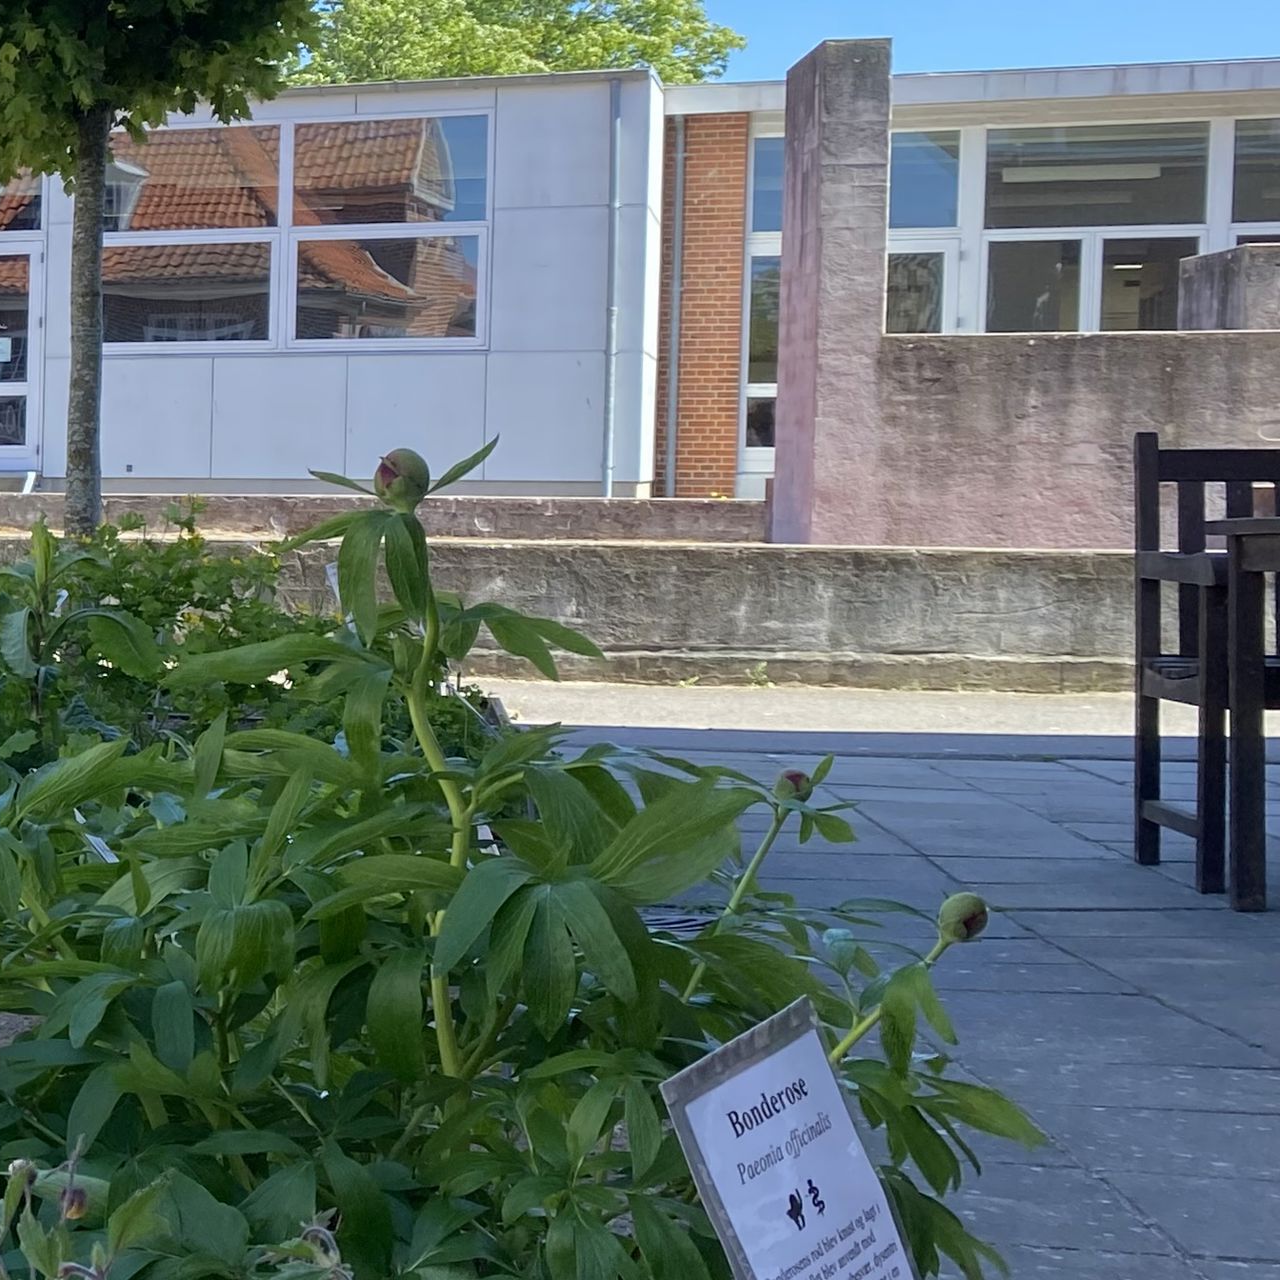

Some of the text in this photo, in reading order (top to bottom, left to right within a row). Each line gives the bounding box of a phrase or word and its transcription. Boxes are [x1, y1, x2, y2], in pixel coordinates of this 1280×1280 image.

[726, 1076, 809, 1138] Bonderose
[736, 1111, 832, 1185] Paeonia officinalis
[821, 1236, 838, 1253] blev
